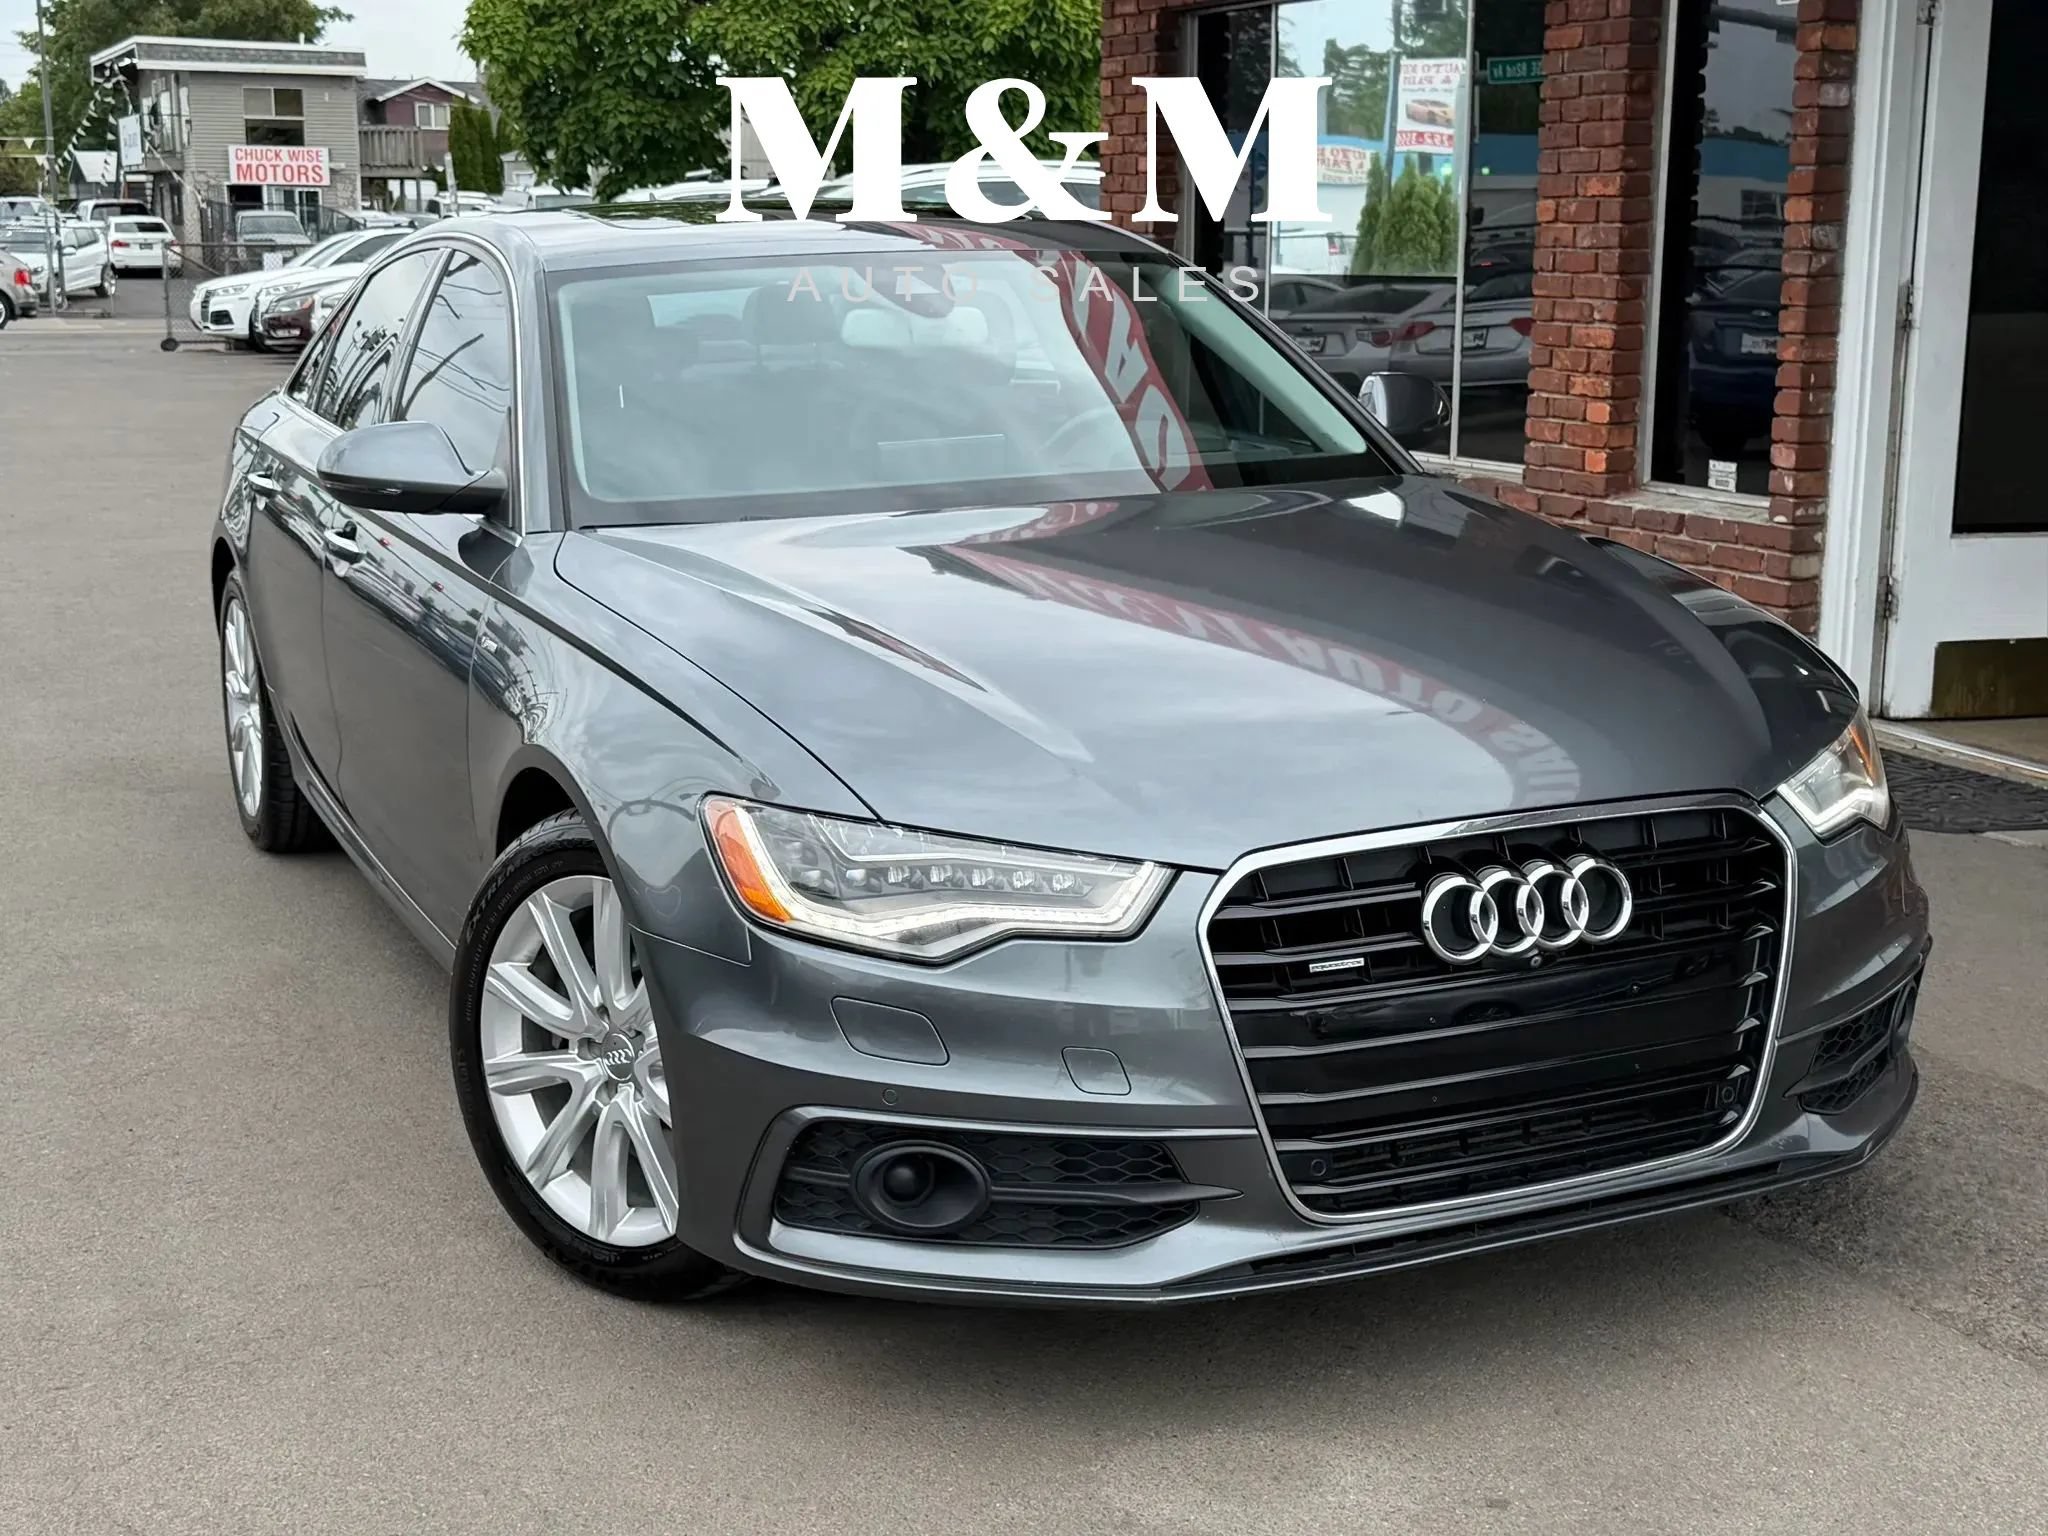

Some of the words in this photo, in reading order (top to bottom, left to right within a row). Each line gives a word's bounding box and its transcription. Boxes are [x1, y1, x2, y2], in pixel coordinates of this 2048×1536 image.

[235, 148, 283, 162] CHUCK
[288, 150, 324, 163] WISE
[236, 164, 324, 183] MOTORS
